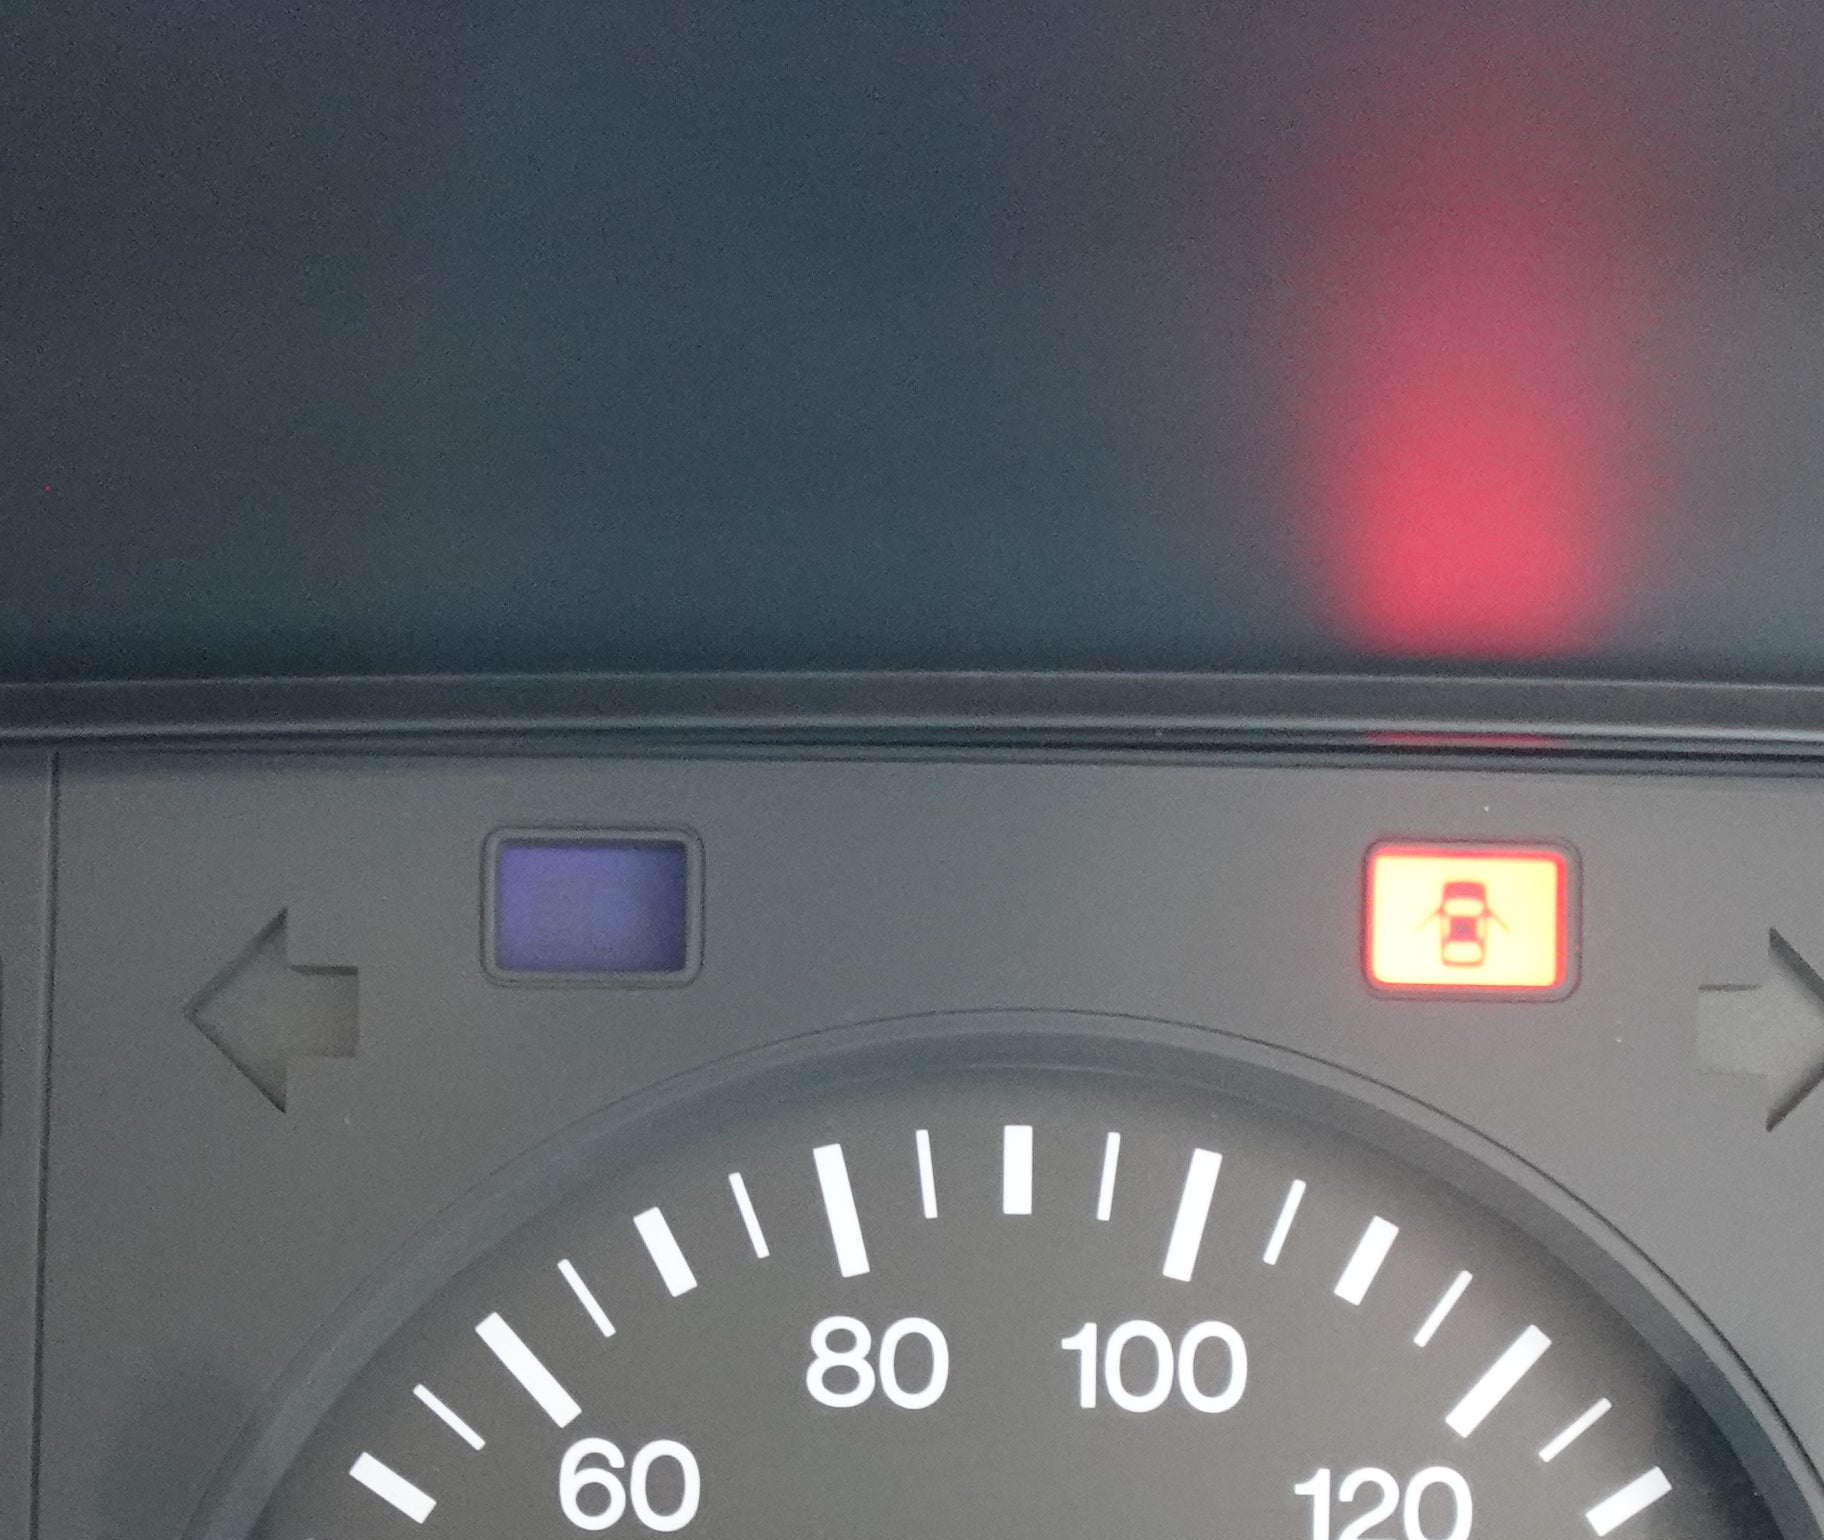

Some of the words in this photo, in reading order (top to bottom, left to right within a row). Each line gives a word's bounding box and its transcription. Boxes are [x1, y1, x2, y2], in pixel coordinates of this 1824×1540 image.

[805, 1314, 951, 1411] 80
[1060, 1318, 1249, 1415] 100
[555, 1438, 702, 1534] 60
